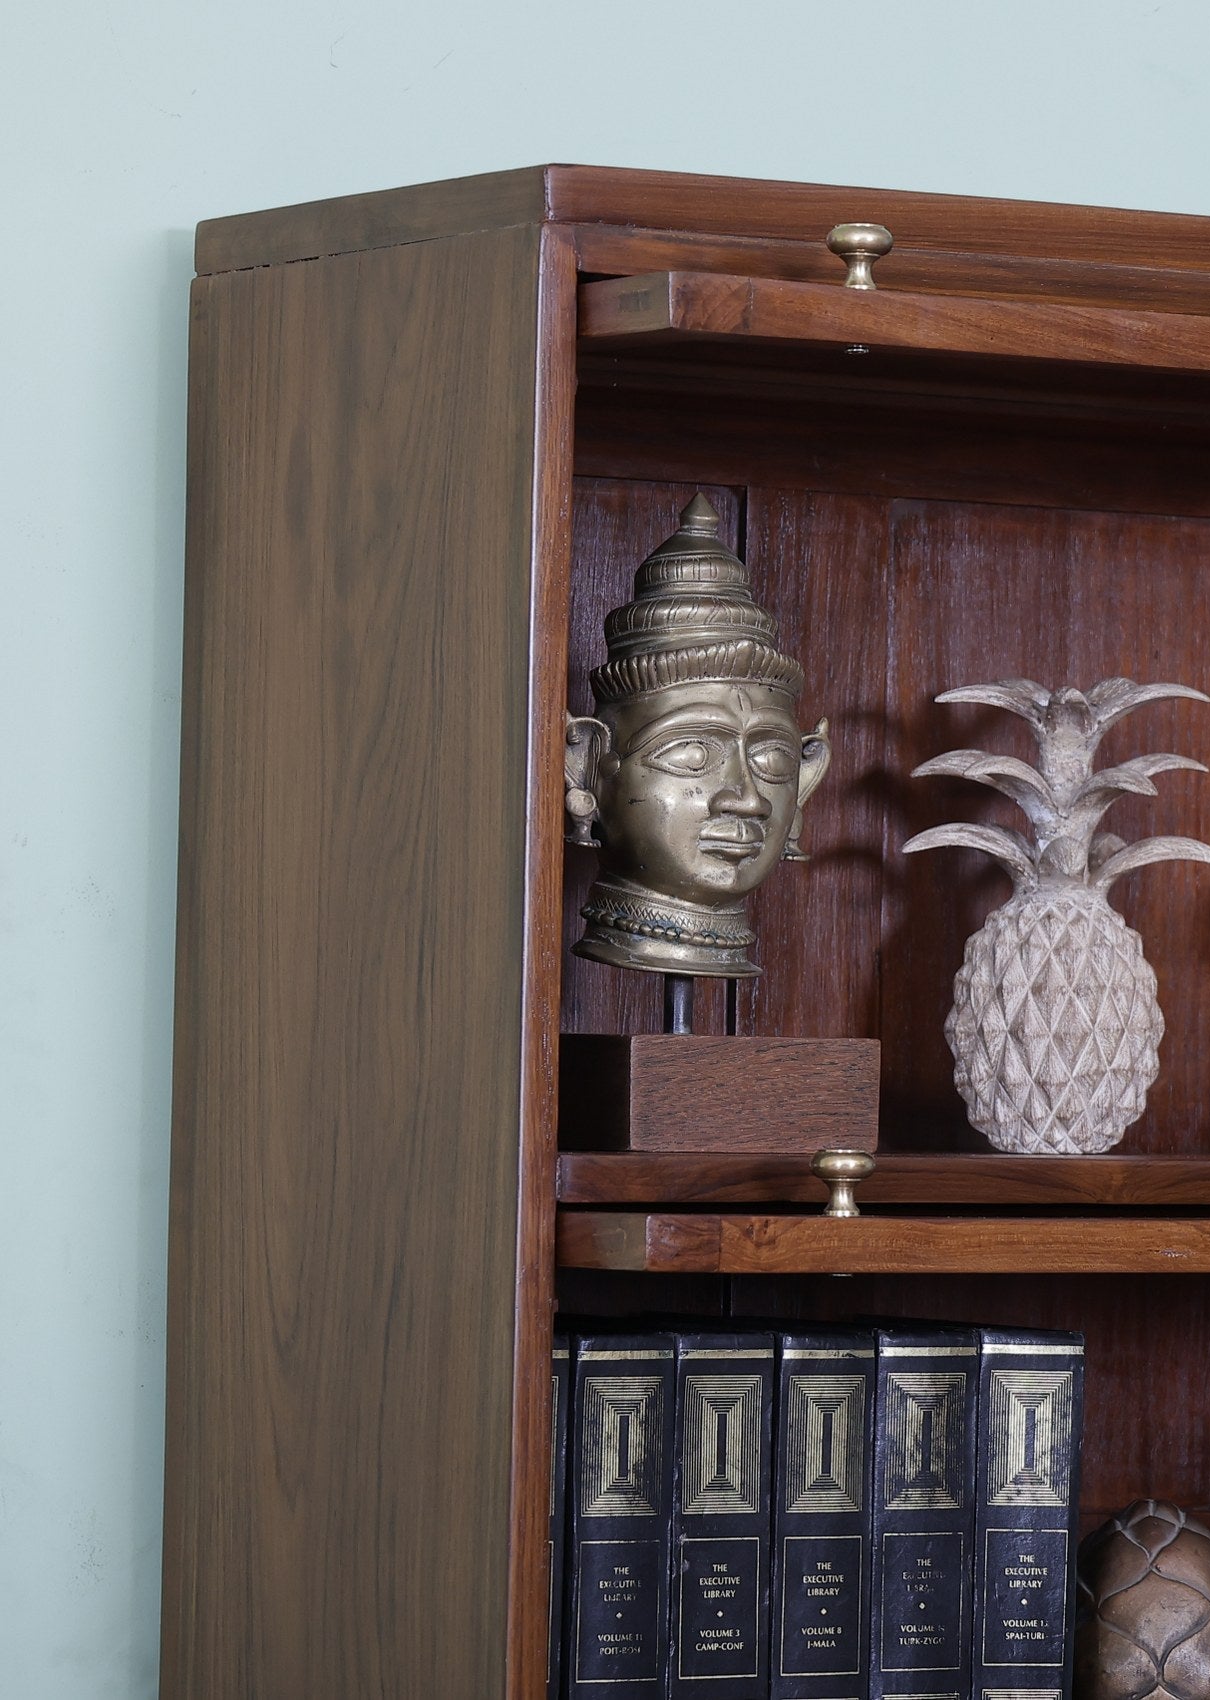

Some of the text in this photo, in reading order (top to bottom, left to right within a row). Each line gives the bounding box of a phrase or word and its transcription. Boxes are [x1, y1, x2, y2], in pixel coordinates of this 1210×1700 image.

[916, 1558, 932, 1567] THE
[1018, 1554, 1035, 1564] THE
[613, 1566, 630, 1576] THE
[712, 1563, 728, 1573] THE
[816, 1561, 832, 1571] THE
[1004, 1567, 1049, 1577] EXECUTIVE
[699, 1576, 741, 1586] EXECUTIVE
[802, 1574, 845, 1584] EXECUTIVE
[1009, 1580, 1043, 1589] LIBRARY
[703, 1589, 736, 1599] LIBRARY
[807, 1587, 840, 1597] LIBRARY
[1003, 1619, 1038, 1628] VOLUME
[699, 1628, 741, 1638] VOLUME 3
[801, 1626, 842, 1635] VOLUME 8
[597, 1633, 633, 1642] VOLUME
[695, 1641, 744, 1652] CAMP-CONF
[807, 1639, 837, 1649] J-MALA
